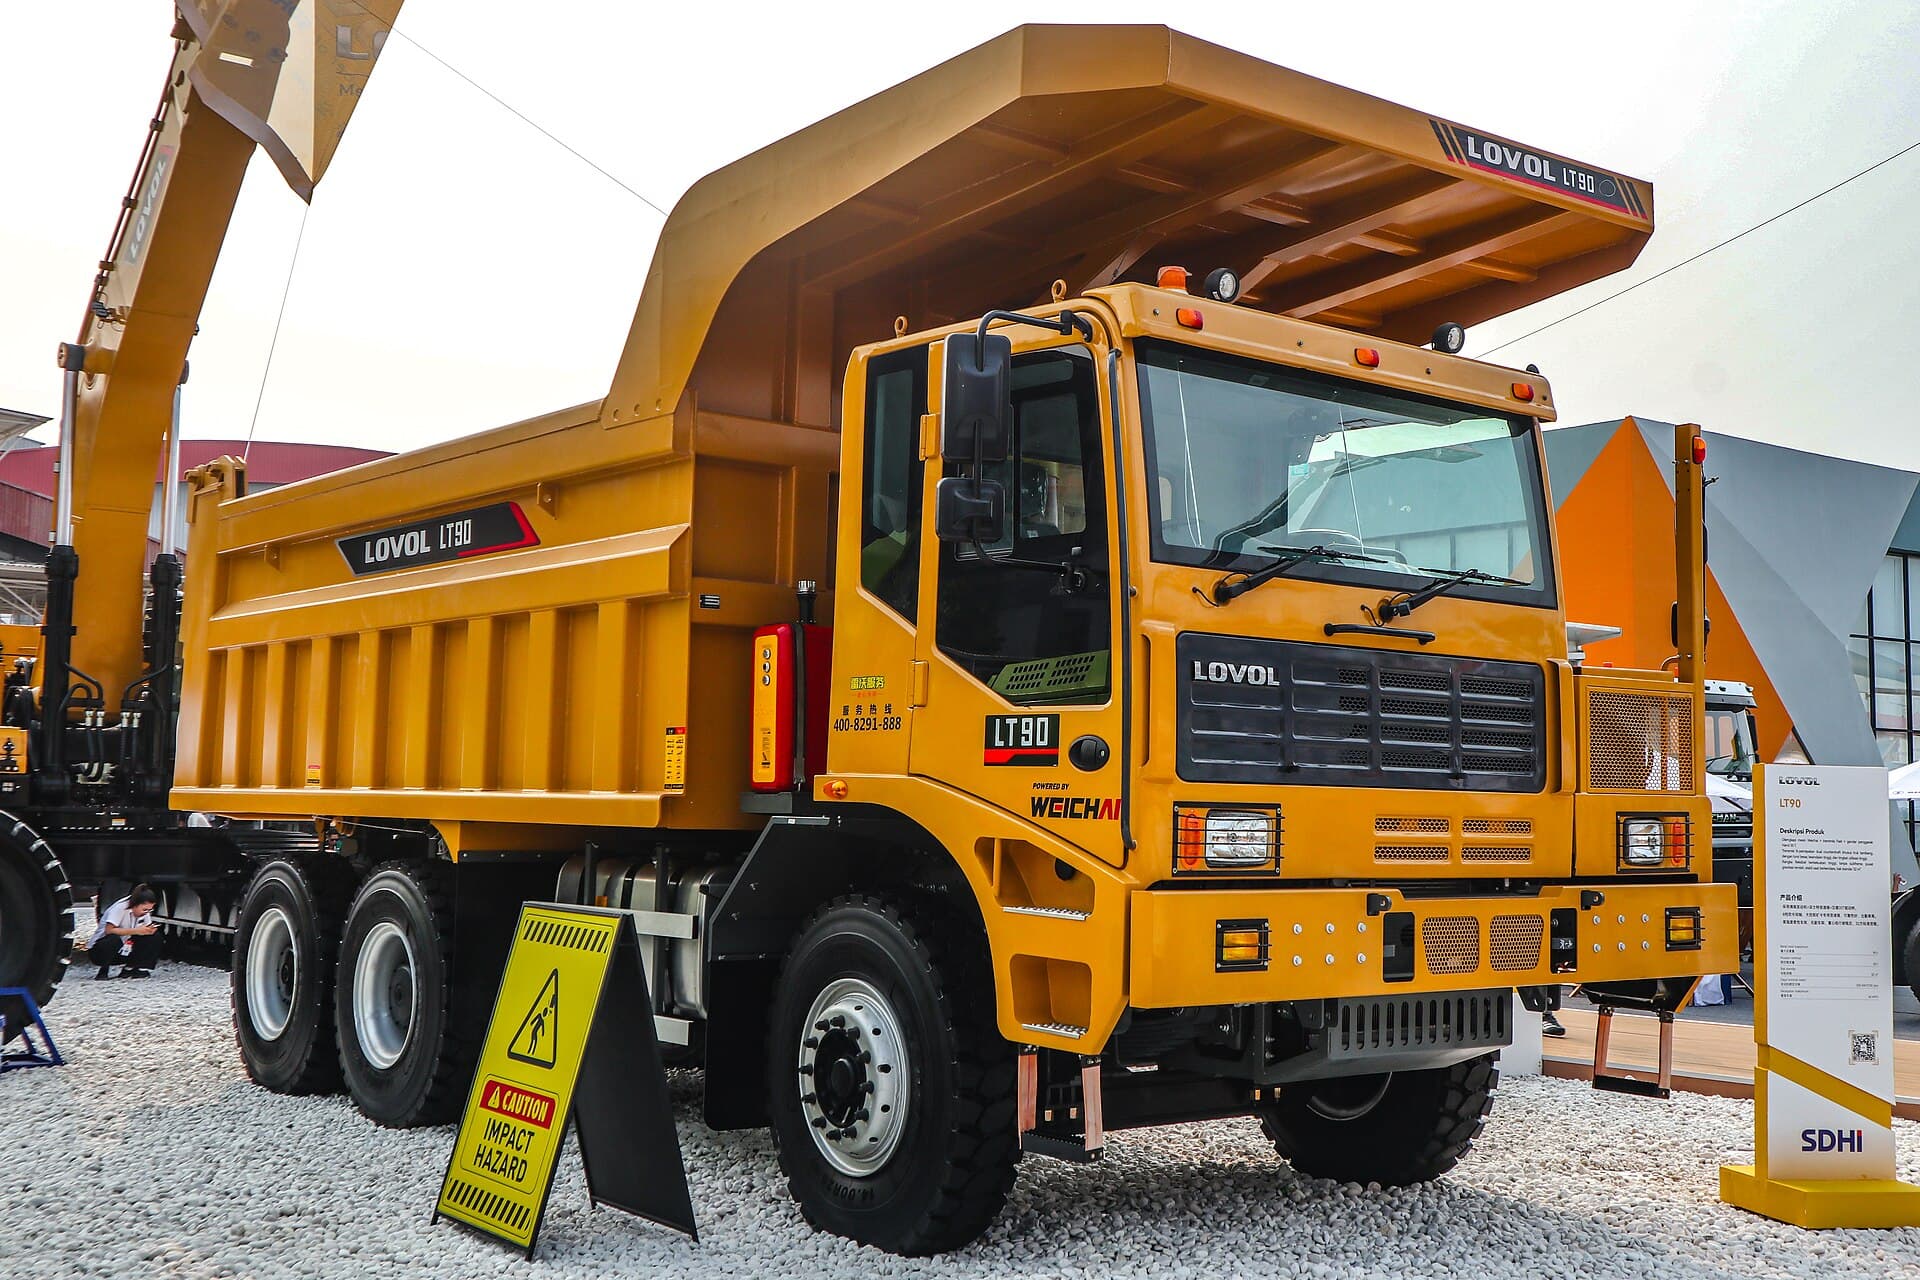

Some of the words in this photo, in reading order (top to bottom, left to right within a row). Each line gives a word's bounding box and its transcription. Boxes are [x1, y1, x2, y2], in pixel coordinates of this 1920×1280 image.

[1467, 135, 1556, 182] LOVOL
[1562, 167, 1595, 193] LT90
[364, 530, 430, 564] LOVOL
[440, 519, 472, 550] LT90
[1193, 660, 1280, 686] LOVOL
[833, 716, 901, 731] 400-8291-888
[994, 717, 1049, 747] LT90
[1032, 782, 1060, 790] POWERED
[1779, 776, 1820, 786] LOVOL
[1031, 796, 1122, 820] WEICHAI
[1780, 799, 1801, 808] LT90
[1780, 827, 1804, 836] Deskripsi
[1805, 828, 1825, 836] Produk
[502, 1090, 549, 1122] CAUTION
[483, 1118, 535, 1154] IMPACT
[473, 1143, 528, 1182] HAZARD
